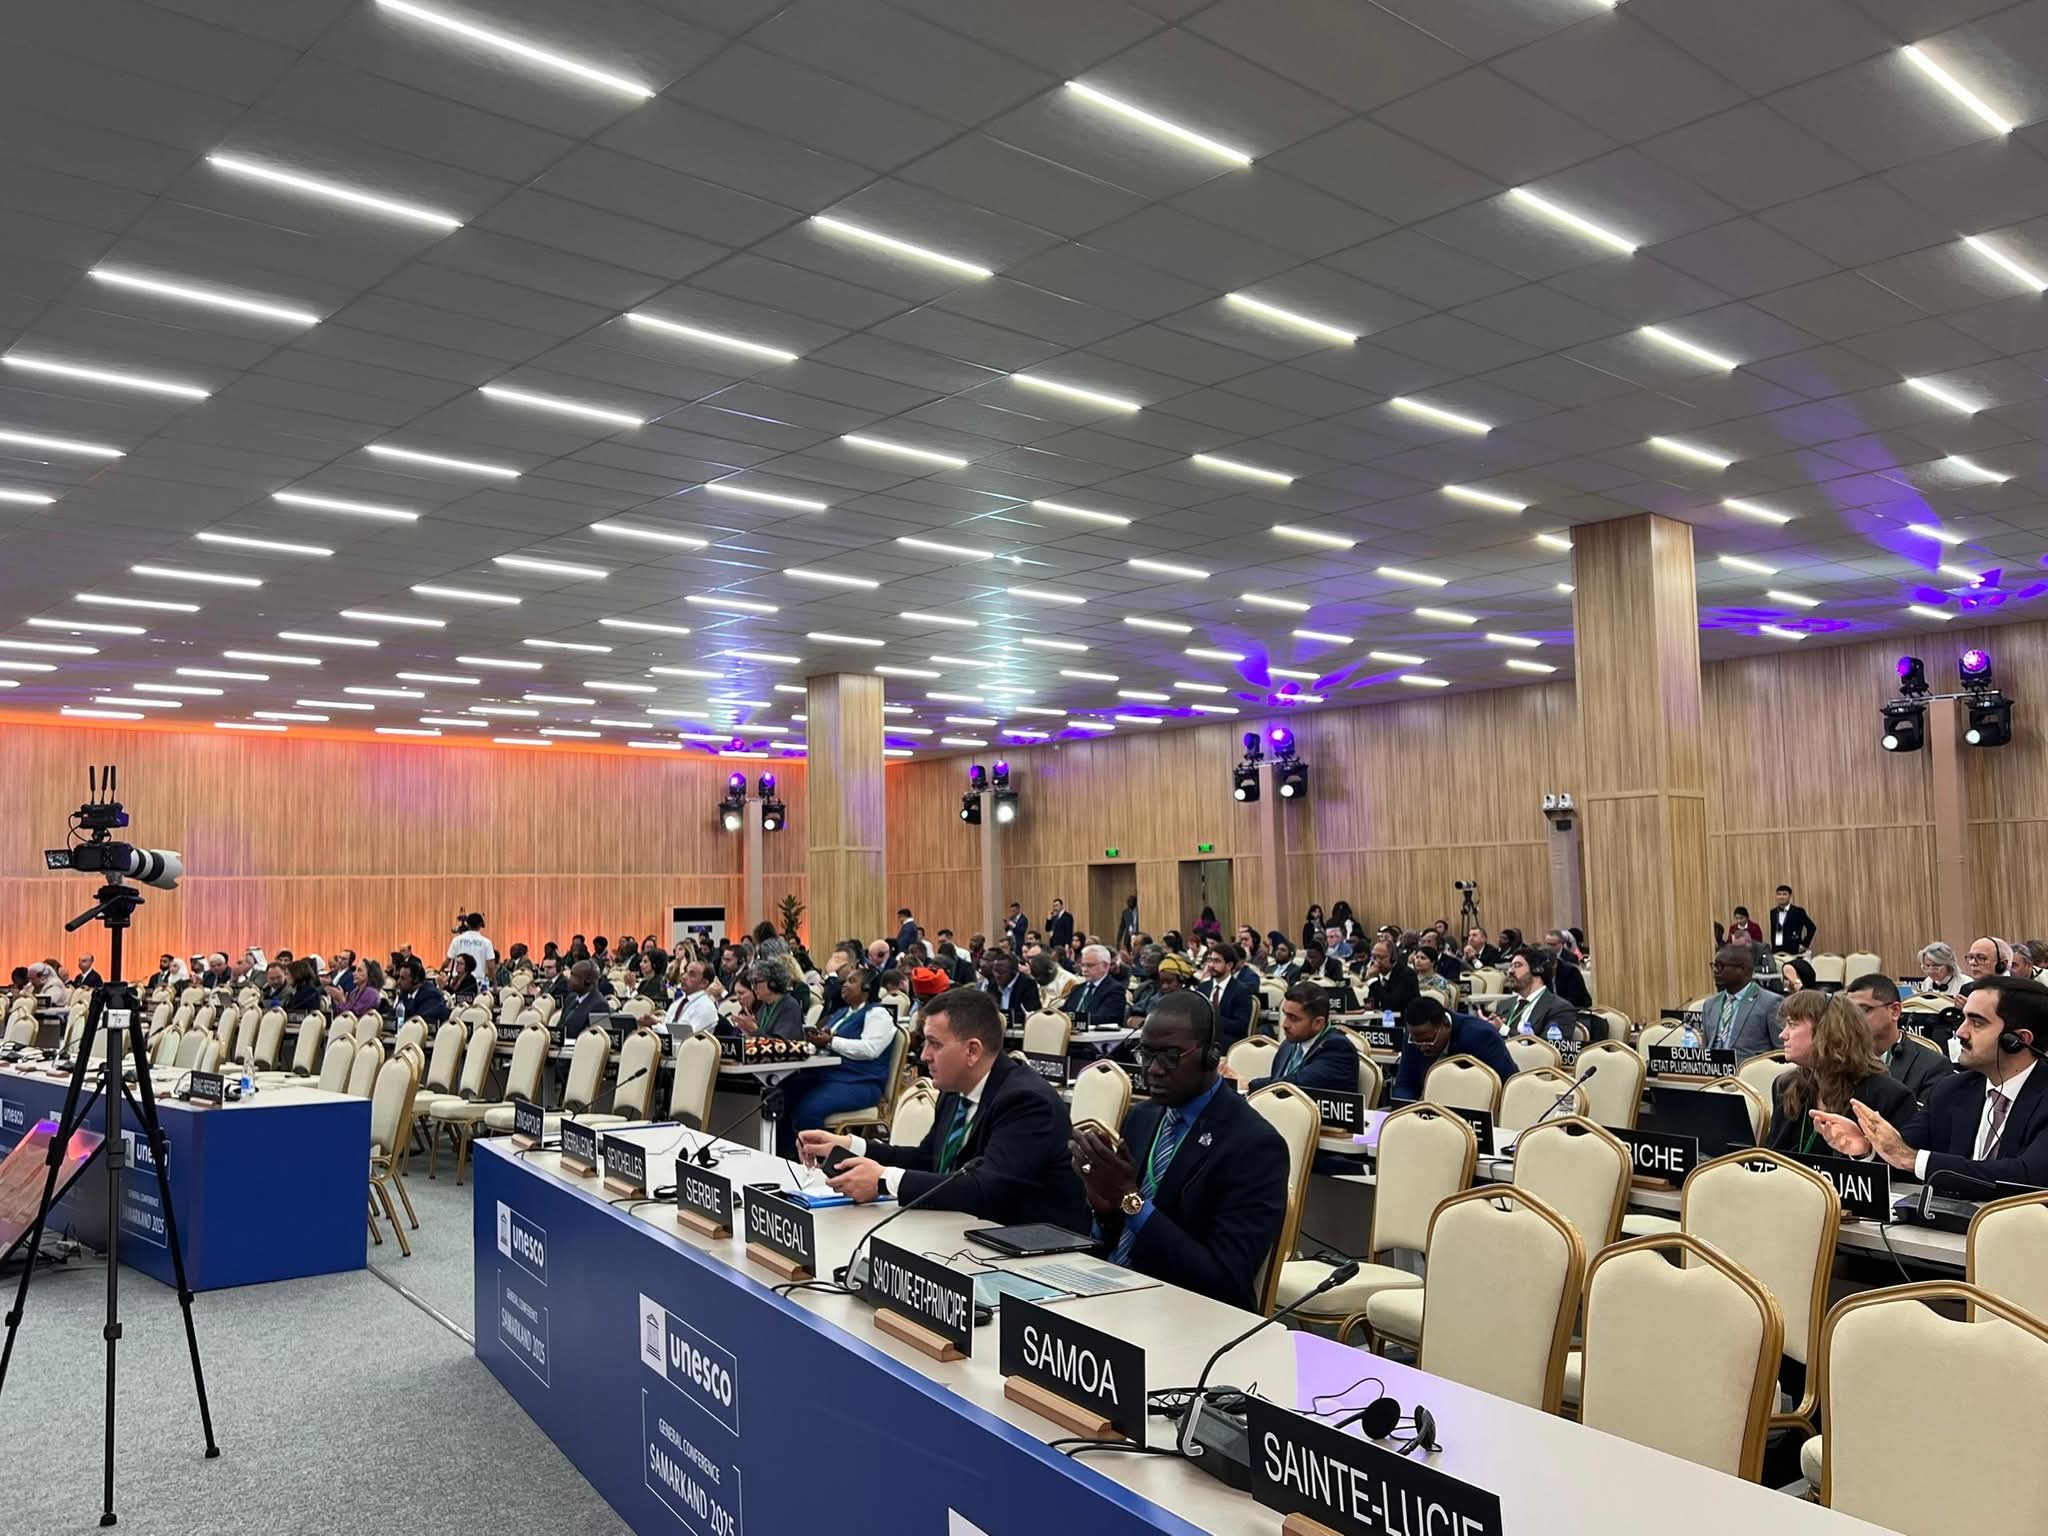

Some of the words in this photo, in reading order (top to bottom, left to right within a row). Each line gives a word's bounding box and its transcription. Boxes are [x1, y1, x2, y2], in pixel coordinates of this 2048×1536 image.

[1669, 1060, 1722, 1076] PLURINATIONAL
[1671, 1047, 1712, 1061] BOLIVIE
[4, 1107, 24, 1125] unesco
[516, 1110, 541, 1135] SINGAPOUR
[1317, 1099, 1354, 1123] ENIE
[606, 1146, 643, 1180] SEYCHELLES
[1622, 1141, 1684, 1172] ICHE
[686, 1177, 722, 1214] SERBIE
[512, 1224, 544, 1268] unesco
[751, 1204, 808, 1256] SENEGAL
[873, 1256, 889, 1294] SAO
[890, 1263, 967, 1332] TOME-ET-PRINCIPE
[670, 1332, 732, 1408] unesco
[1023, 1326, 1118, 1405] SAMOA
[658, 1418, 683, 1452] GENERAL
[682, 1438, 721, 1485] CONFERENCE
[650, 1443, 708, 1519] SAMARKAND
[710, 1499, 735, 1536] 2025
